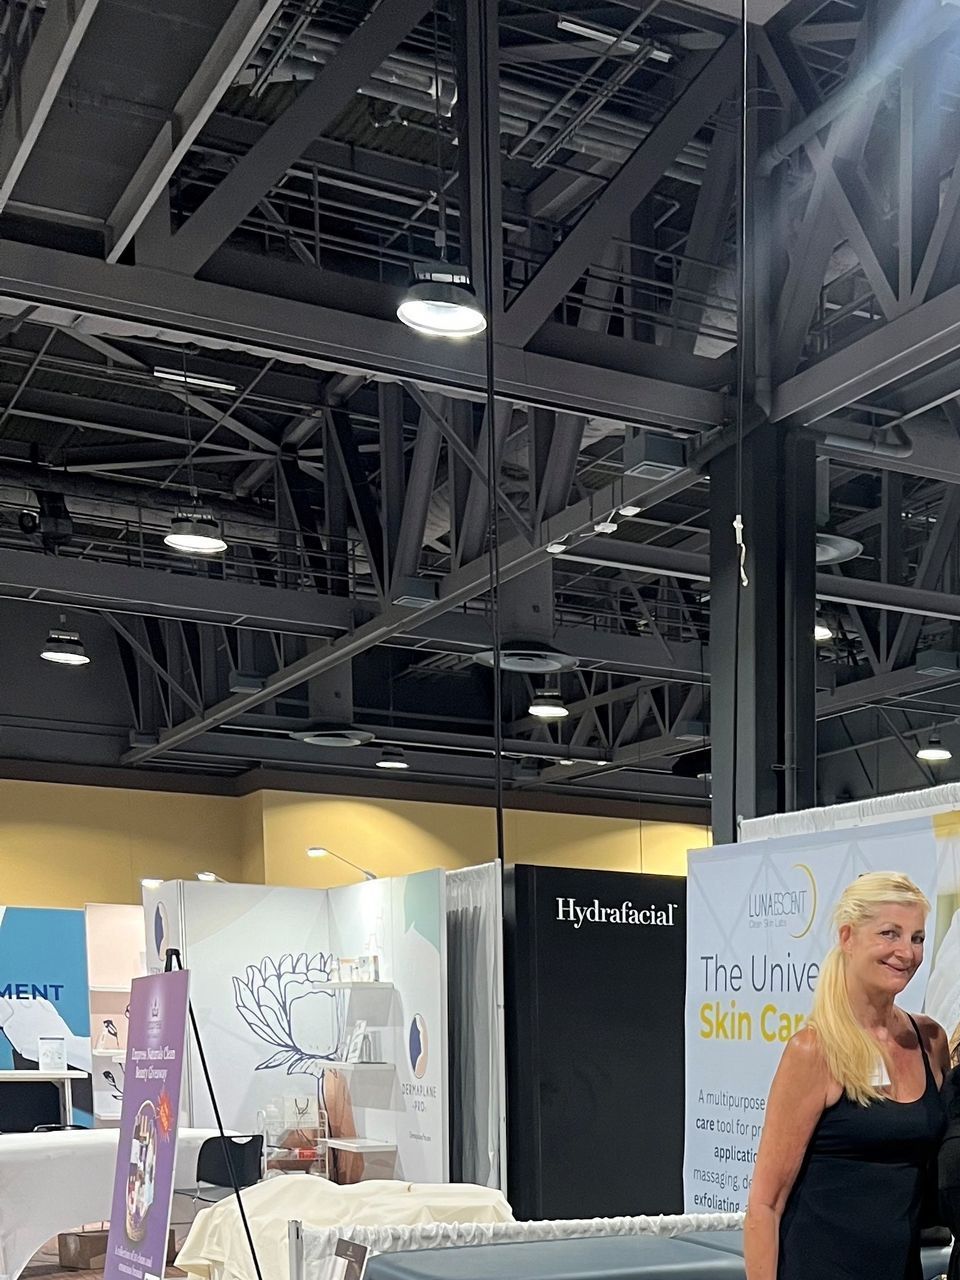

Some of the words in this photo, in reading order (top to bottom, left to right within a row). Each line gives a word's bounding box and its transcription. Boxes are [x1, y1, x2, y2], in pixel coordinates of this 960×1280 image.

[700, 953, 743, 992] The
[751, 952, 820, 992] Unive
[699, 1000, 752, 1040] Skin
[760, 1003, 806, 1042] Car
[698, 1088, 705, 1103] A
[706, 1091, 766, 1112] multipurpose
[696, 1117, 715, 1131] care
[716, 1118, 734, 1135] tool
[736, 1119, 749, 1135] for
[693, 1168, 740, 1192] massaging,
